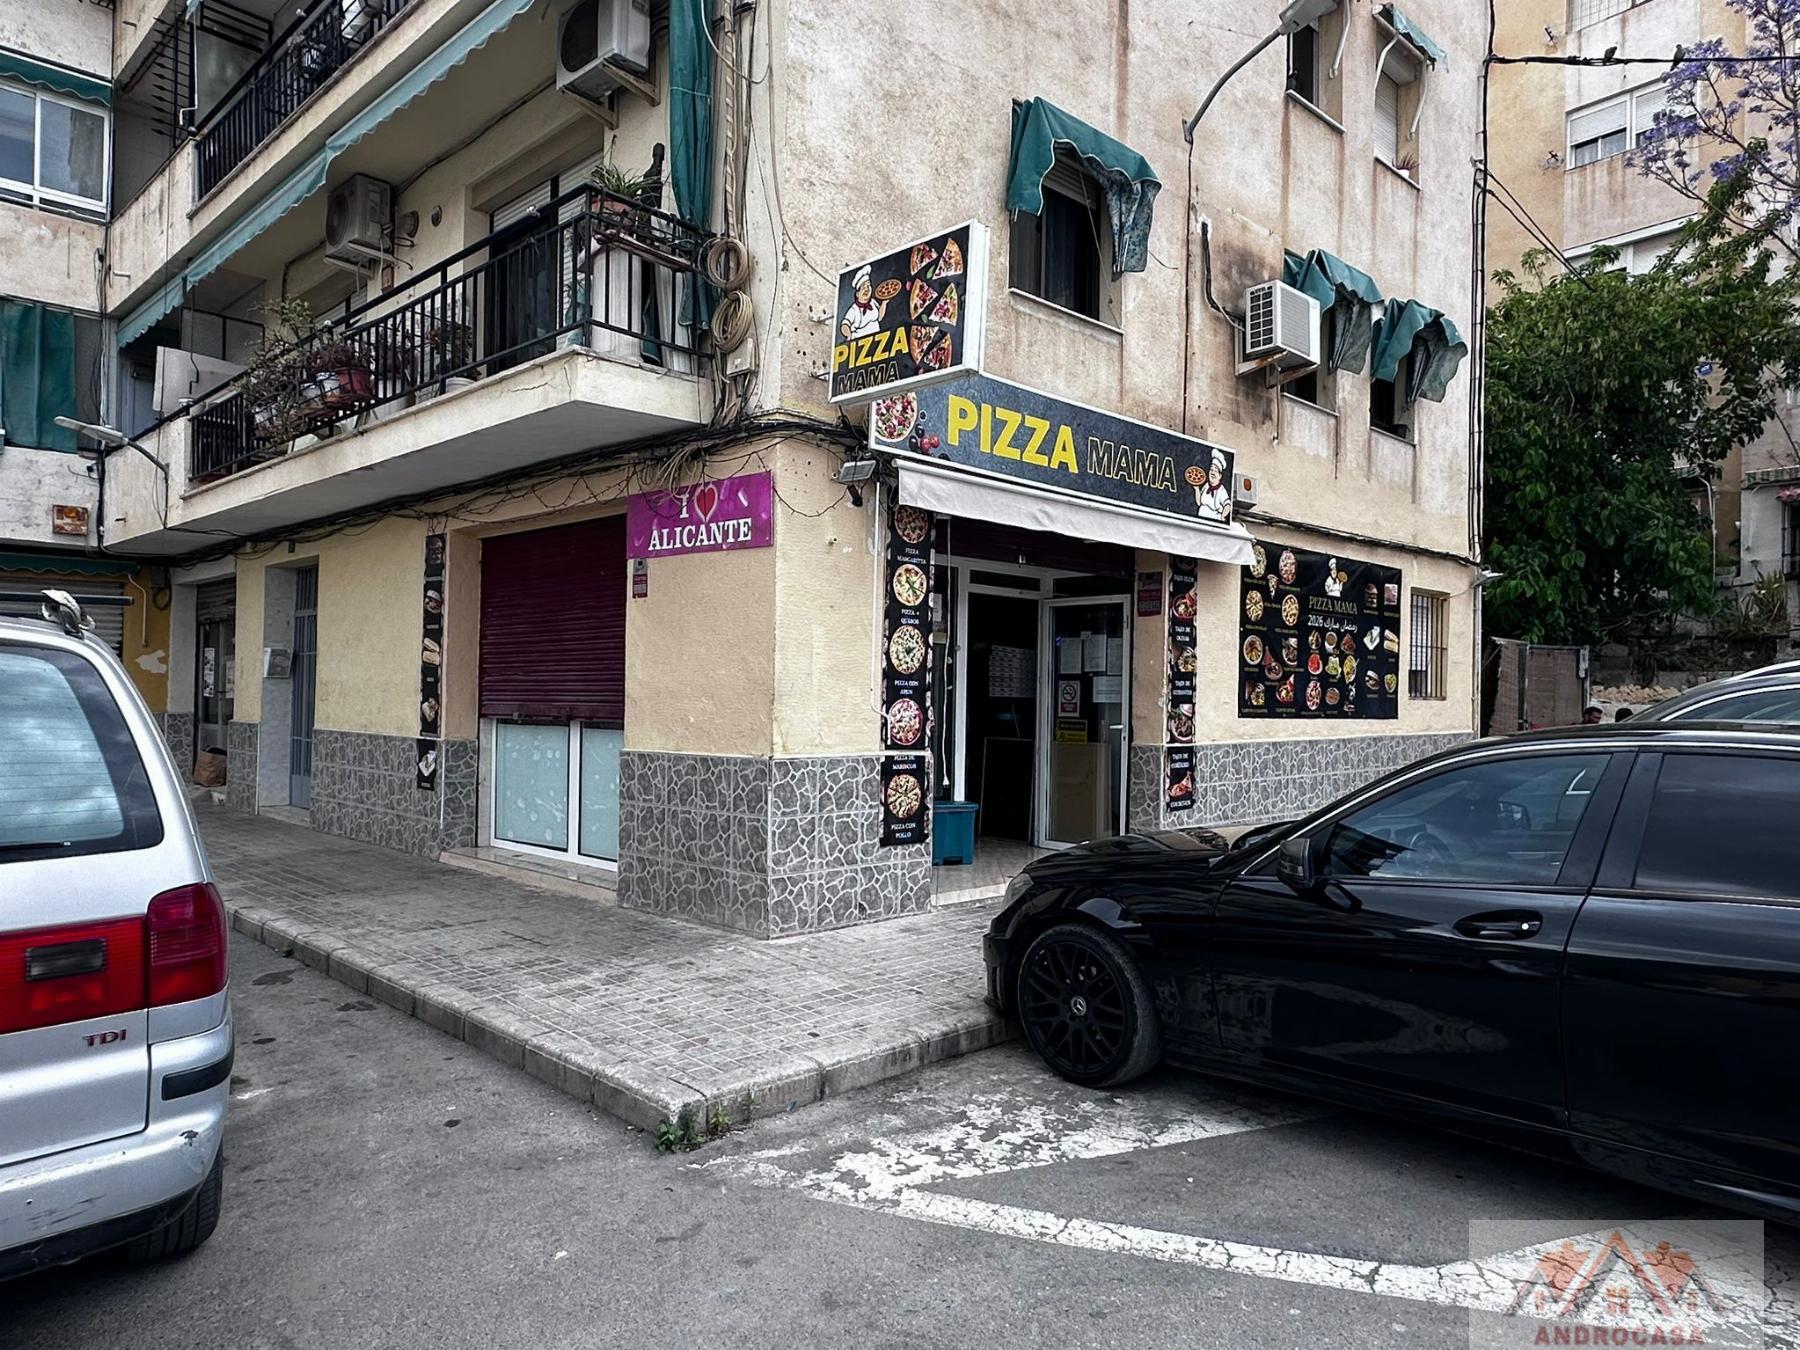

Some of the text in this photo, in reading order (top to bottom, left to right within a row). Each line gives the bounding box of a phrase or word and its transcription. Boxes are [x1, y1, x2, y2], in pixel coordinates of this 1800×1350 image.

[833, 326, 909, 373] PIZZA
[836, 360, 900, 396] MAMA
[947, 394, 1178, 493] PIZZA MAMA
[648, 517, 752, 551] ALICANTE
[905, 547, 919, 555] PIZZA
[901, 608, 915, 616] PIZZA
[1308, 595, 1358, 615] PIZZA MAMA
[894, 679, 908, 687] PIZZA
[83, 1029, 127, 1047] TDI
